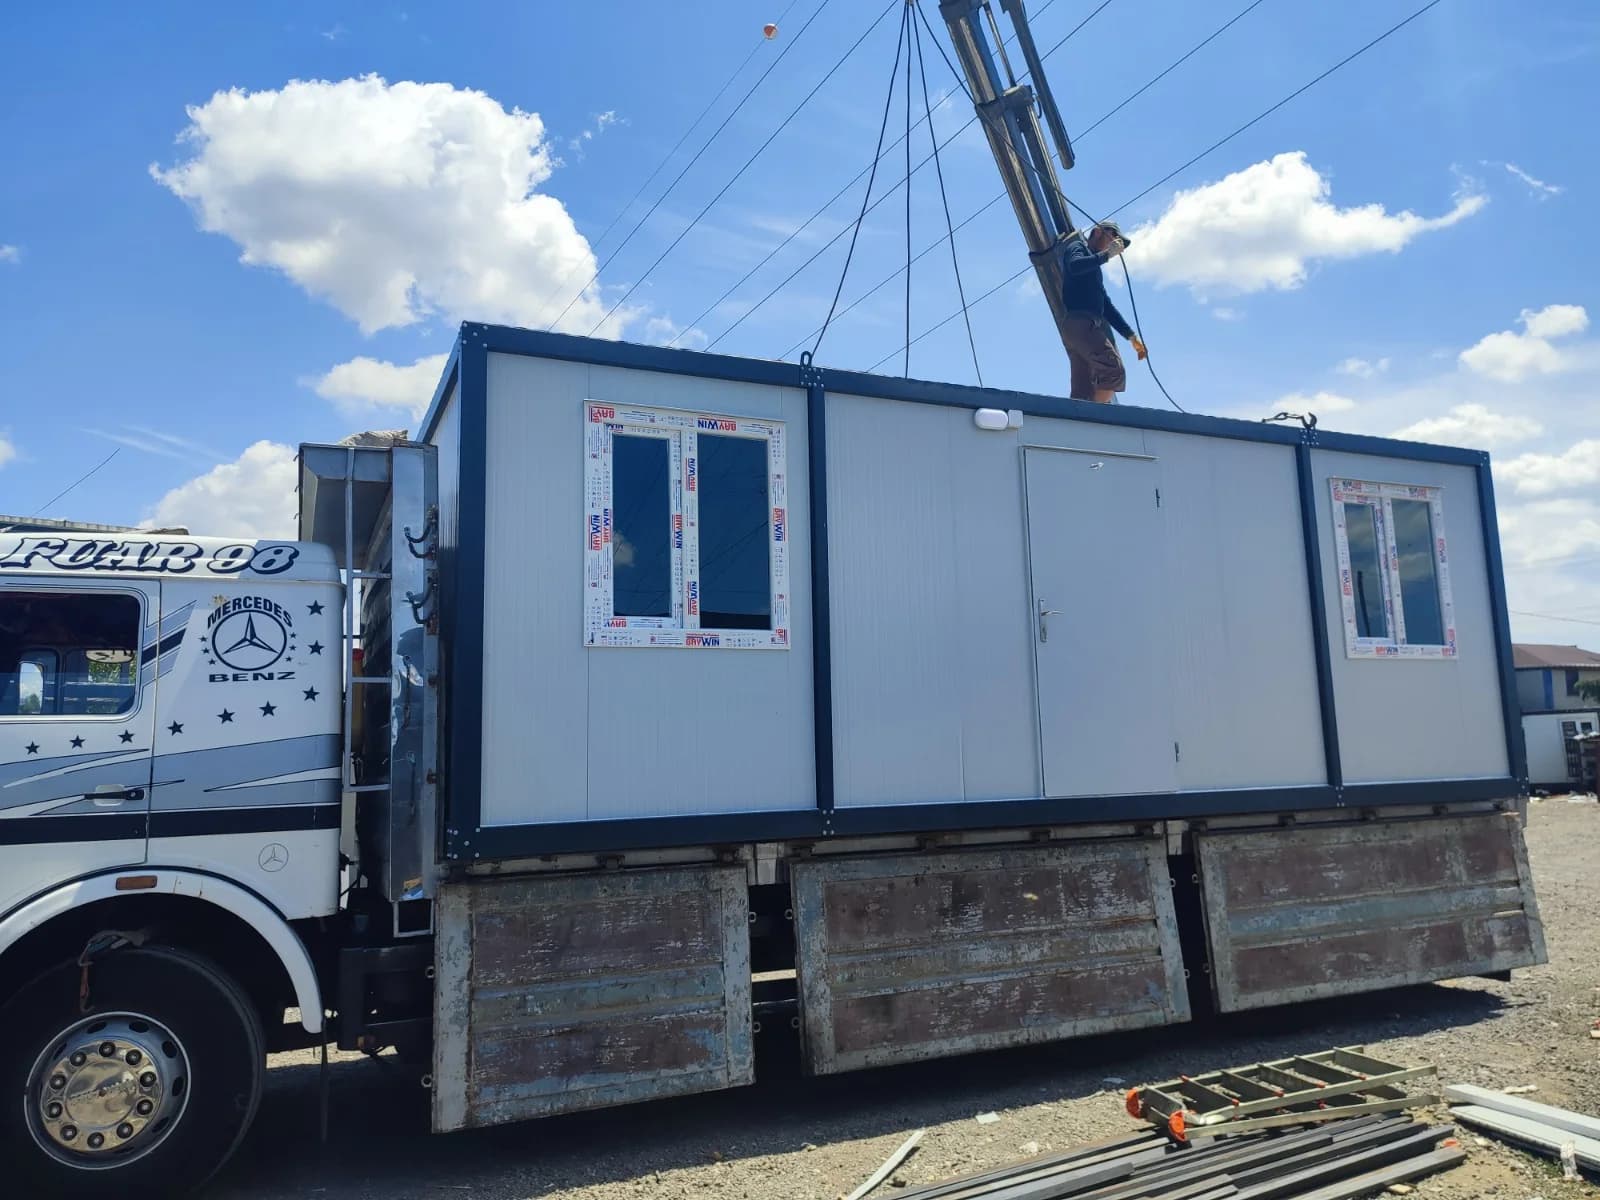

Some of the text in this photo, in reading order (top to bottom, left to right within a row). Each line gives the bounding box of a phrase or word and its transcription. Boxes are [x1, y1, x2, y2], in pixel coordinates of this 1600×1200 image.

[697, 418, 737, 431] BAYWIN
[206, 544, 299, 574] 98
[207, 595, 293, 628] MERCEDES
[685, 637, 720, 647] BAYWIN
[209, 671, 296, 683] BENZ
